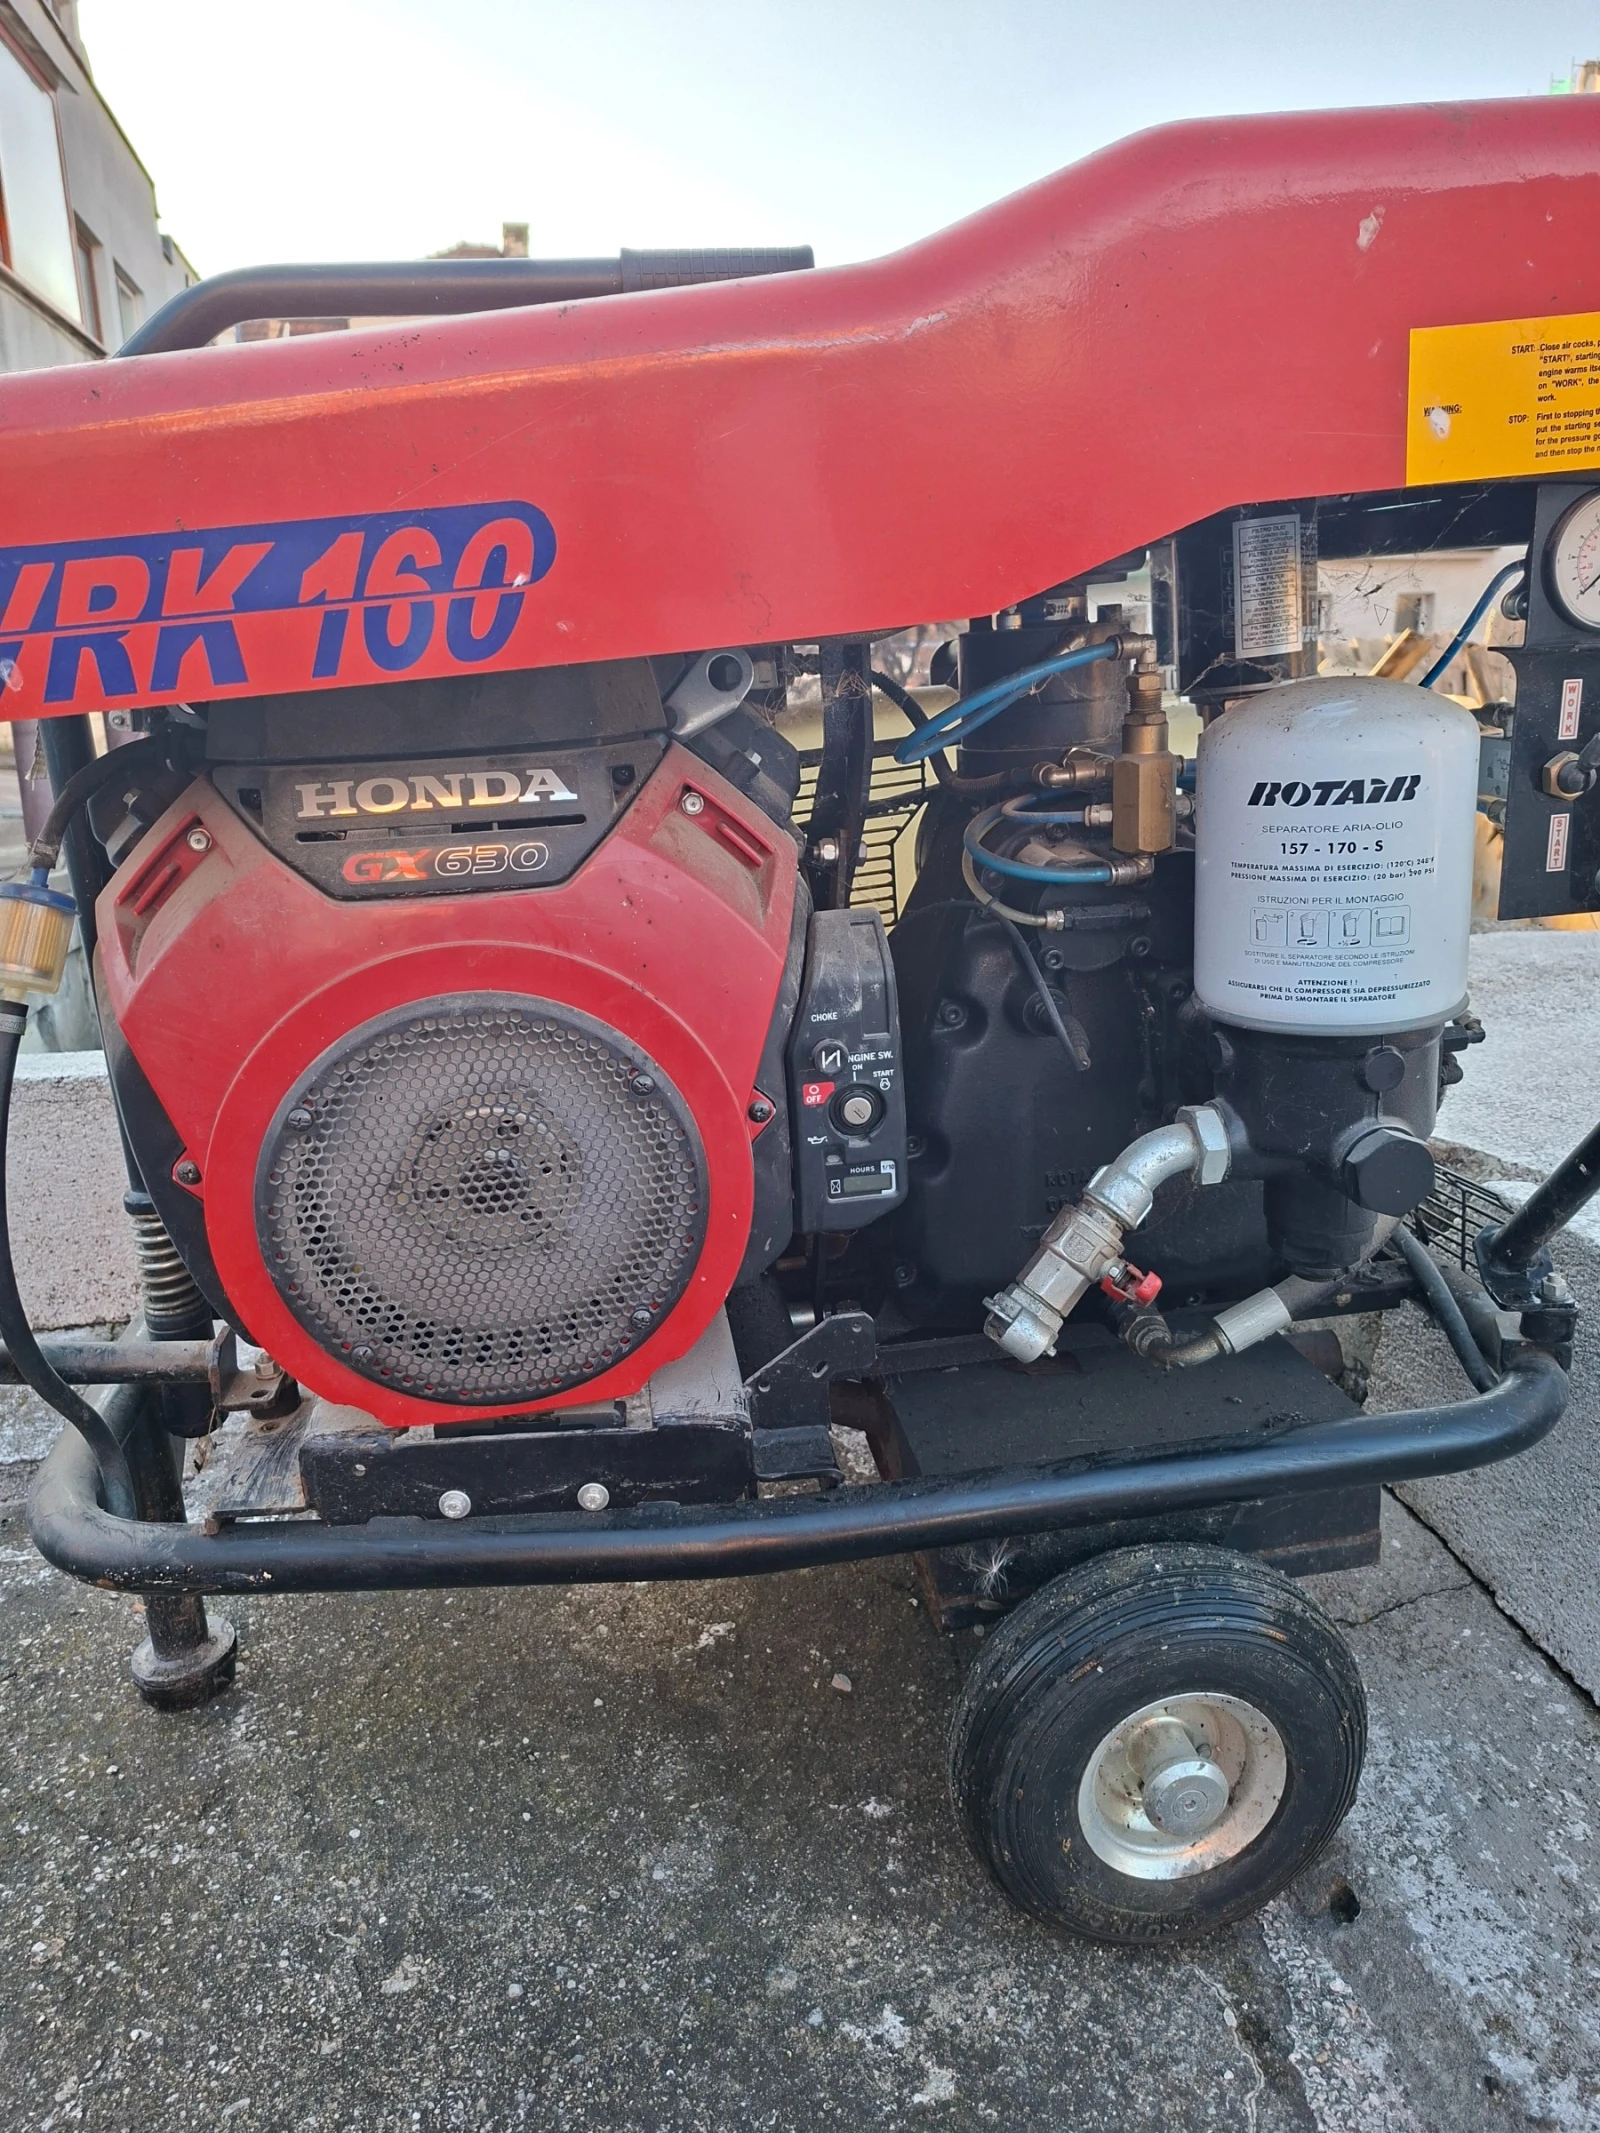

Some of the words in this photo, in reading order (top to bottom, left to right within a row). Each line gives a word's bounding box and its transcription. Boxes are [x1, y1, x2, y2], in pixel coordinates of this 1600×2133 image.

[1512, 344, 1535, 354] START:
[1540, 343, 1560, 352] Close
[1562, 341, 1572, 349] air
[1573, 340, 1596, 348] cocks,
[1539, 368, 1562, 378] engine
[1564, 366, 1587, 374] warms
[1538, 394, 1556, 402] work.
[1508, 414, 1529, 424] STOP:
[1536, 412, 1552, 420] First
[1563, 408, 1594, 418] stopping
[1536, 426, 1548, 435] put
[1550, 424, 1561, 432] the
[1564, 421, 1591, 430] starting
[1560, 434, 1591, 444] pressure
[1535, 449, 1548, 458] and
[1550, 448, 1565, 457] then
[1567, 447, 1582, 455] stop
[1584, 445, 1595, 453] the
[300, 517, 535, 680] 160
[1565, 685, 1577, 733] WORK
[295, 768, 578, 817] HONDA
[1247, 774, 1421, 807] ROTAIR
[1261, 825, 1340, 834] SEPARATORE
[1343, 821, 1404, 832] ARIA-OLIO
[1280, 843, 1309, 855] 157
[1327, 842, 1357, 854] 170
[1374, 840, 1383, 852] S
[1553, 819, 1563, 866] START
[342, 849, 432, 883] GX
[435, 842, 549, 876] 630
[1231, 861, 1279, 871] TEMPERATURA
[1337, 863, 1383, 871] ESERCIZIO:
[1386, 860, 1414, 869] (120°C)
[1231, 872, 1267, 881] PRESSIONE
[1323, 874, 1370, 882] ESERCIZIO:
[1373, 873, 1387, 881] (20
[1424, 867, 1435, 875] PSI
[1257, 895, 1309, 905] ISTRUZIONI
[1312, 896, 1332, 905] PER
[1335, 897, 1344, 905] IL
[1345, 892, 1405, 904] MONTAGGIO
[1244, 950, 1279, 959] SOSTITUIRE
[1380, 949, 1415, 958] ISTRUZIONI
[1282, 960, 1336, 968] MANUTENZIONE
[1352, 958, 1404, 967] COMPRESSORE
[1228, 980, 1267, 991] ASSICURARSI
[1294, 987, 1351, 995] COMPRESSORE
[1368, 979, 1431, 993] DEPRESSURIZZATO
[1260, 992, 1283, 1001] PRIMA
[1349, 993, 1396, 1002] SEPARATORE
[811, 1012, 838, 1022] CHOKE
[848, 1052, 876, 1063] NGINE
[877, 1050, 894, 1060] SW.
[851, 1063, 863, 1071] ON
[872, 1069, 895, 1078] START
[806, 1094, 822, 1103] OFF
[850, 1165, 875, 1174] HOURS
